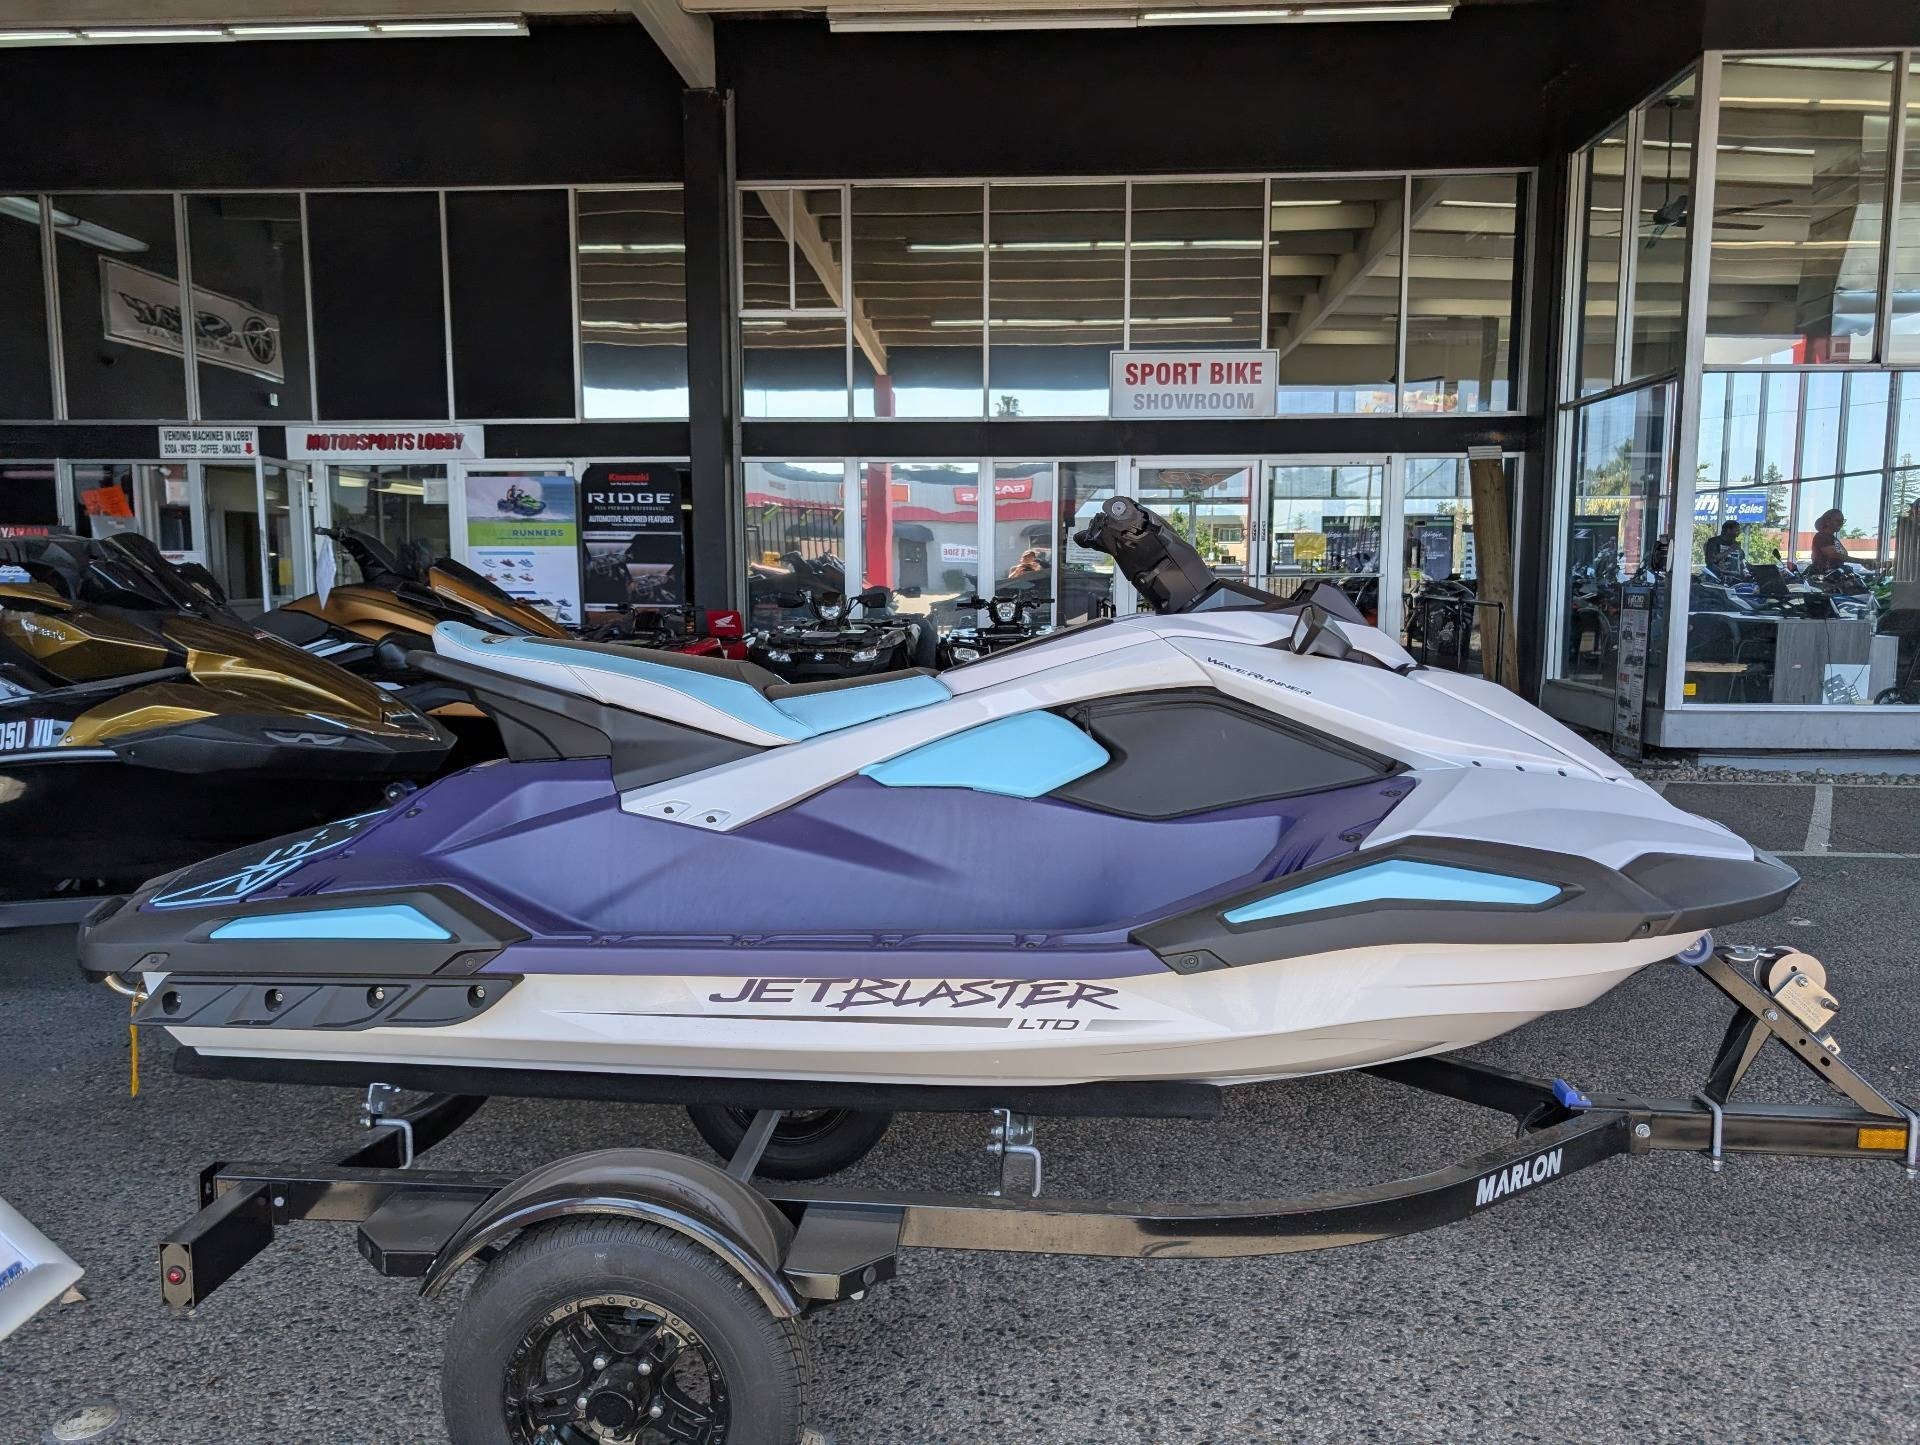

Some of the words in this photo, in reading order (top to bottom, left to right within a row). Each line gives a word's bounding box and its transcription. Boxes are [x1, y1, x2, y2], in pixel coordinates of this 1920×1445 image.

[1125, 362, 1202, 386] SPORT
[1209, 362, 1263, 386] BIKE
[1133, 392, 1254, 411] SHOWROOM
[163, 430, 192, 441] VENDING
[192, 430, 224, 441] MACHINES
[225, 430, 232, 441] IN
[233, 430, 253, 441] LOBBY
[306, 433, 415, 451] MOTORSPORTS
[416, 432, 465, 450] LOBBY
[164, 444, 178, 454] SODA
[180, 444, 197, 454] WATER
[200, 444, 219, 454] COFFEE
[222, 444, 242, 454] SNACKS
[587, 492, 671, 504] RIDGE
[1738, 503, 1764, 514] Sales
[588, 515, 648, 523] AUTOMOTIVE-INSPIRED
[648, 515, 674, 524] FEATURES
[0, 527, 49, 538] YAMAHA
[33, 718, 55, 747] VU
[1017, 1018, 1080, 1031] LTD
[1475, 1147, 1563, 1207] MARLON
